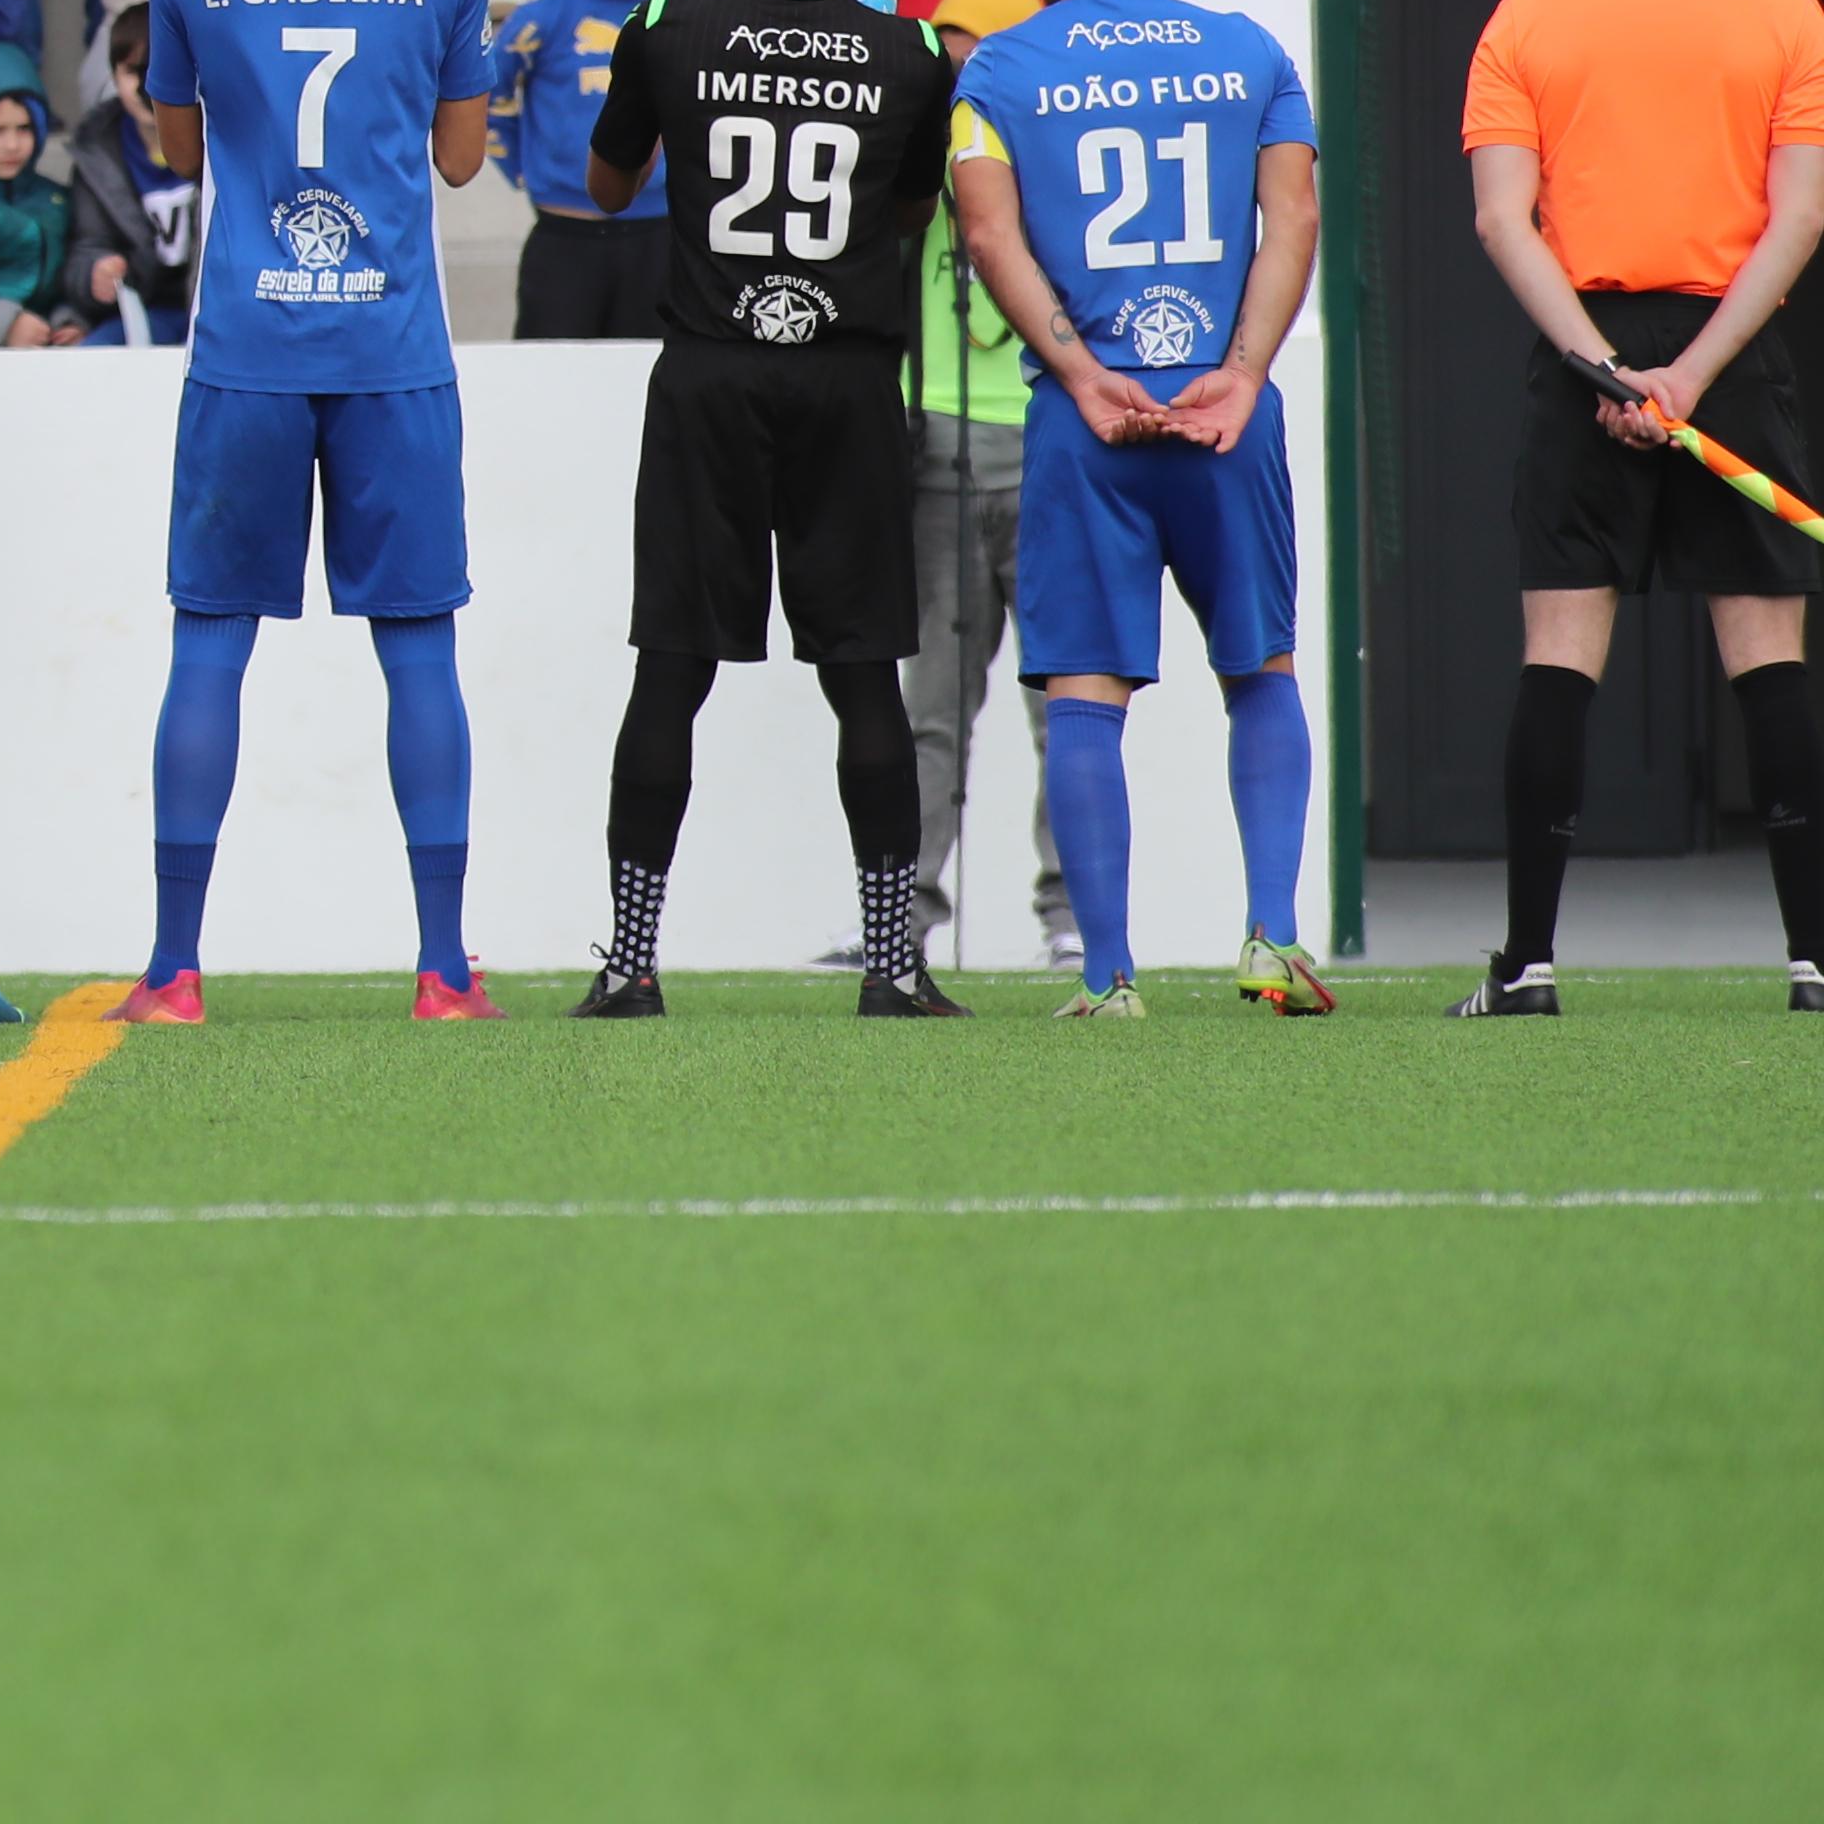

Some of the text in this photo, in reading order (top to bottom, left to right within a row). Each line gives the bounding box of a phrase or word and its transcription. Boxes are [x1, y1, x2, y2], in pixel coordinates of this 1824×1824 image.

[725, 24, 870, 64] AÇORES
[1066, 20, 1201, 51] AÇORES
[281, 27, 357, 169] 7
[697, 70, 882, 114] IMERSON
[1035, 72, 1247, 115] JOÃO FLOR
[708, 115, 861, 261] 29
[1077, 122, 1223, 270] 21
[297, 188, 371, 240] CERVEJARIA
[256, 268, 386, 293] estrela da noite
[732, 285, 757, 320] CAFÉ
[764, 274, 839, 322] CERVEJARIA
[1112, 298, 1137, 337] CAFÉ
[1143, 284, 1215, 334] CERVEJARIA
